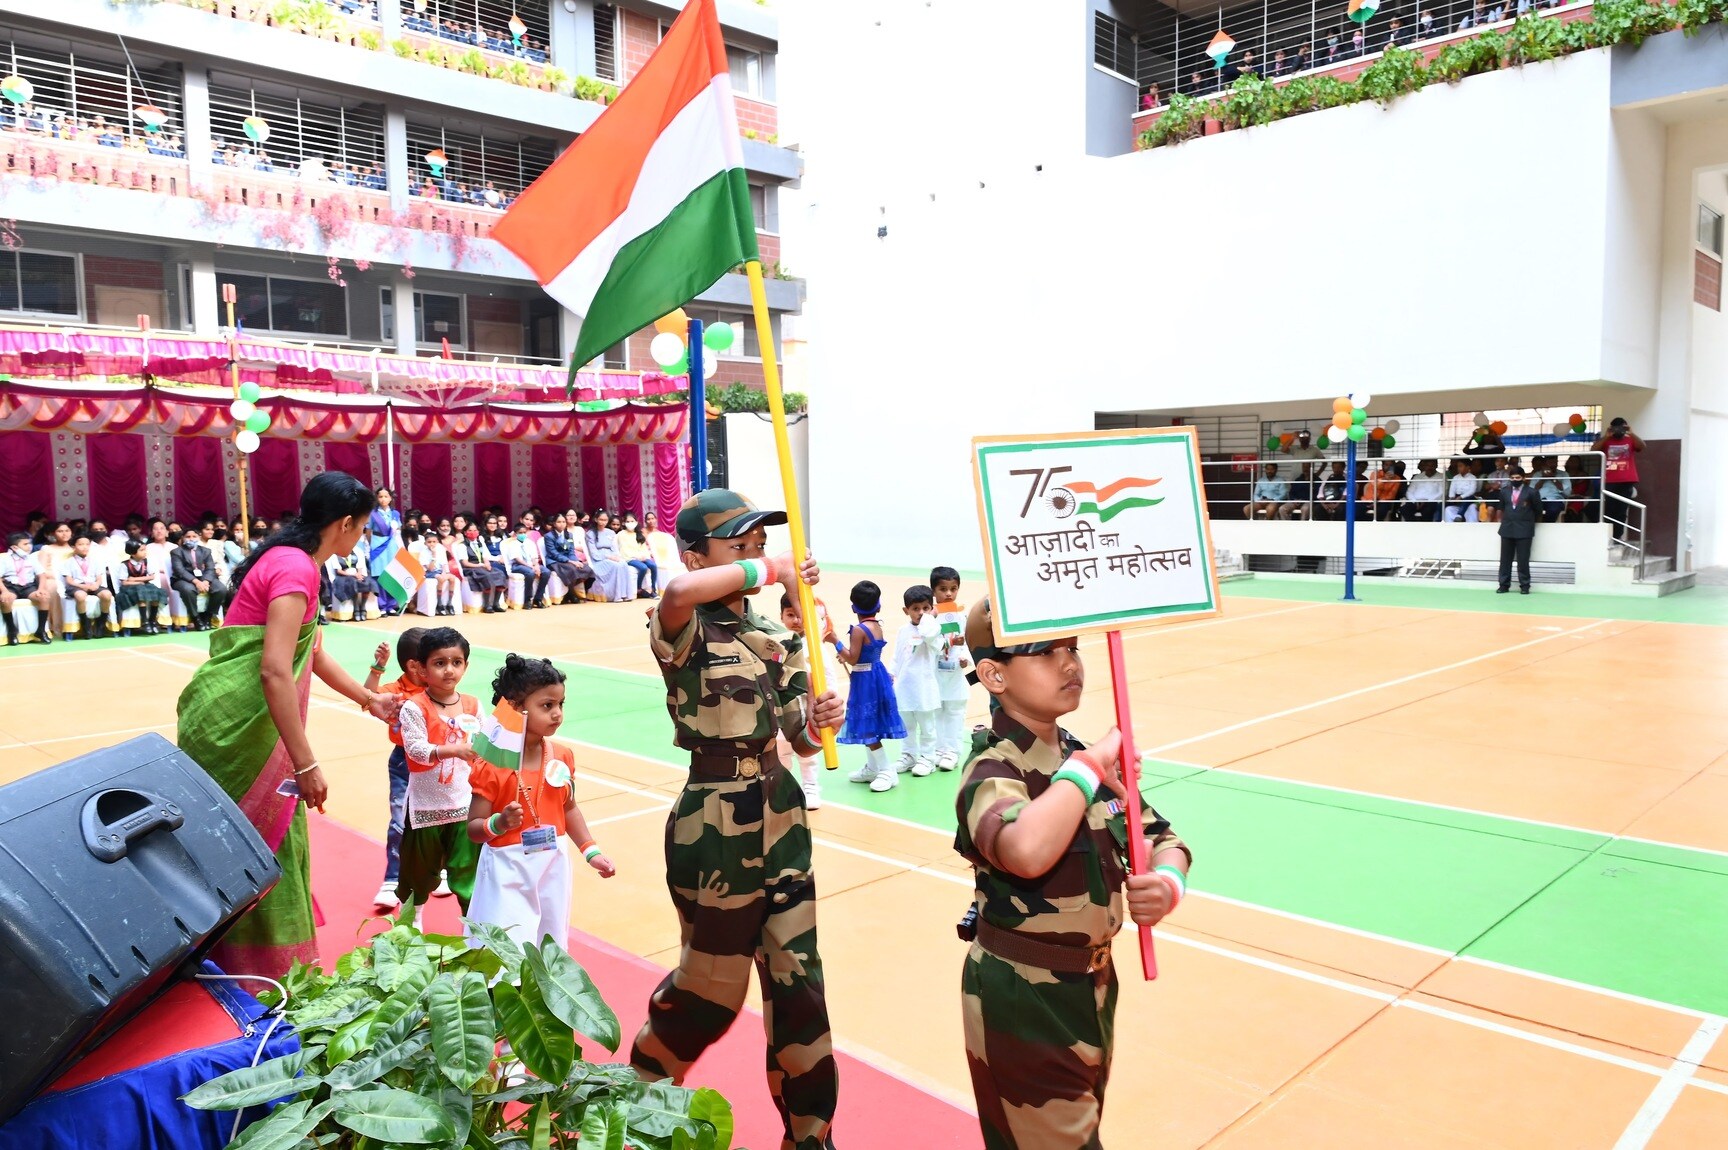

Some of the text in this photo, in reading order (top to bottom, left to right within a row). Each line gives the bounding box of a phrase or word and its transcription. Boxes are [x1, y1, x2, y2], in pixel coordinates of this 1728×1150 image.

[1009, 465, 1076, 519] 75
[1005, 519, 1120, 558] आज़ादी का
[1036, 544, 1193, 590] अमृत महोत्सव
